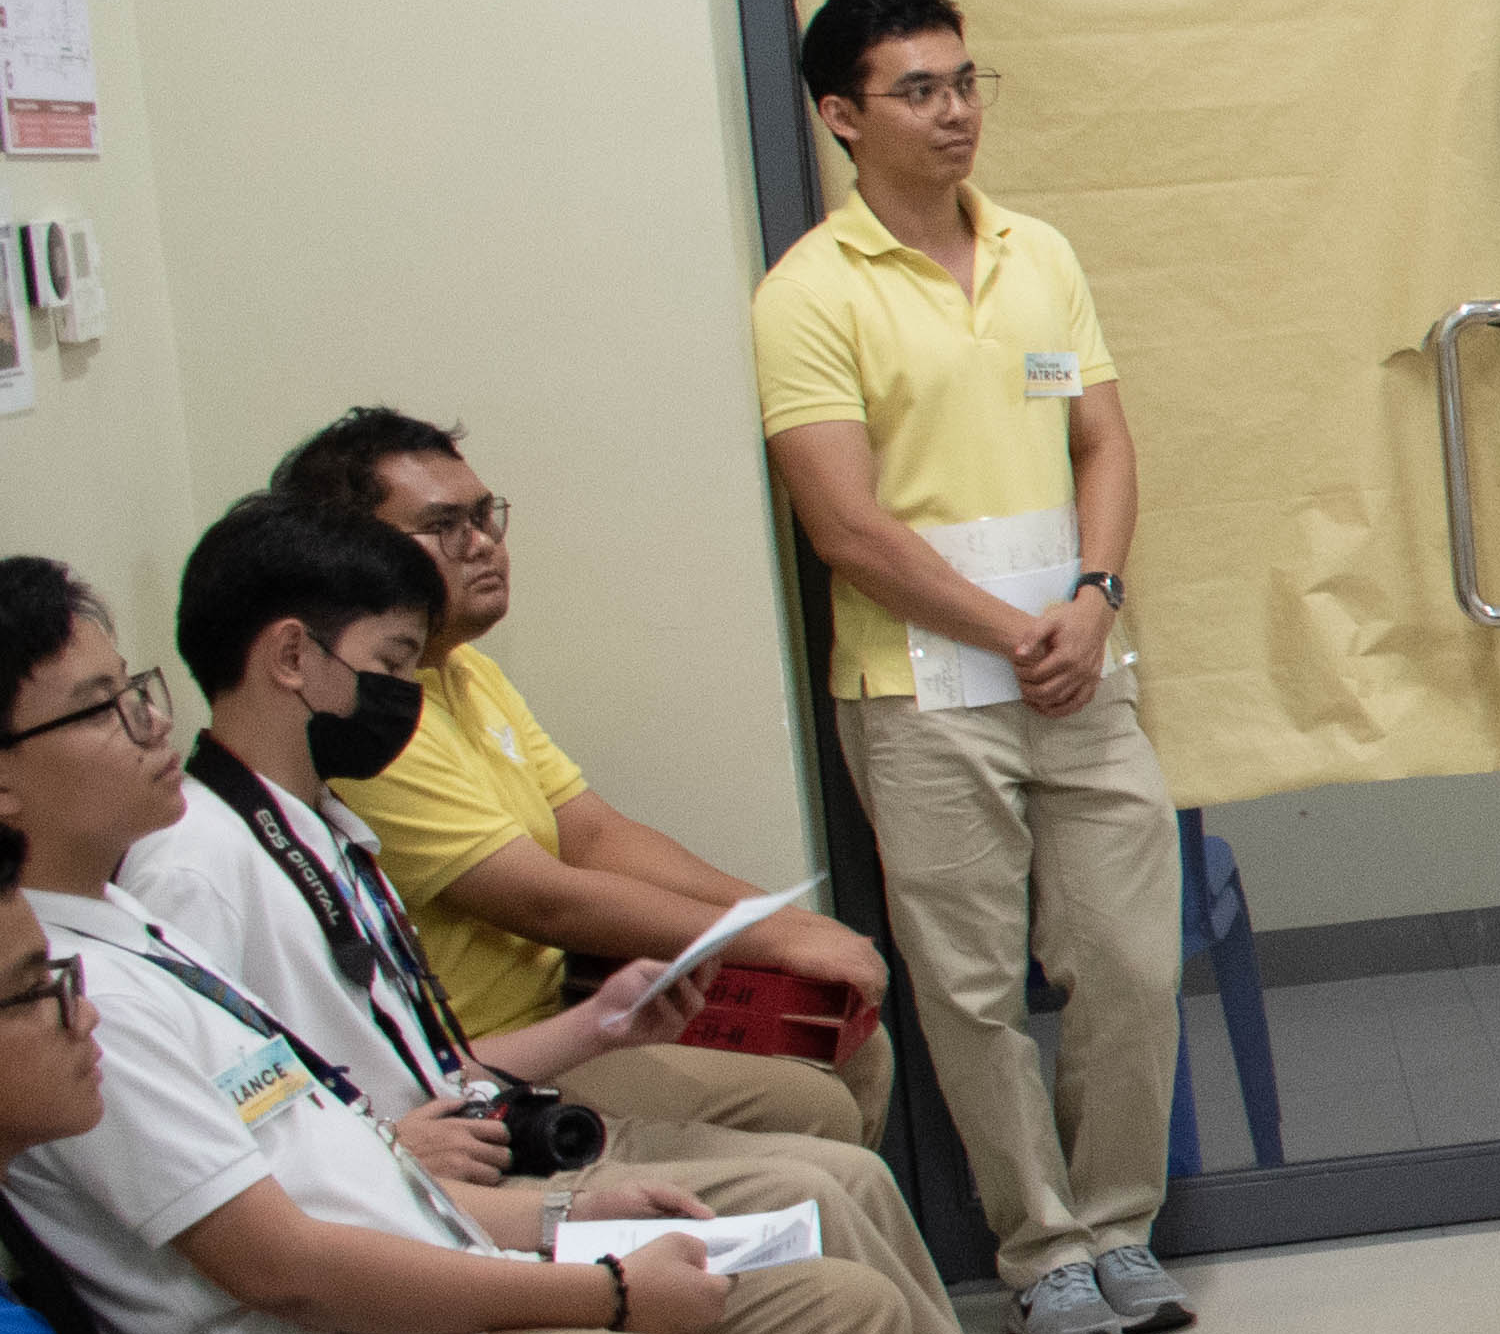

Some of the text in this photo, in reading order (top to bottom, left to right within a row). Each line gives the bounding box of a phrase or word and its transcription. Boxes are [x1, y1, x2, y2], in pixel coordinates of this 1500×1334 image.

[1027, 370, 1072, 381] PATRICK
[256, 809, 339, 926] EOS DIGITAL
[231, 1062, 288, 1105] LANCE
